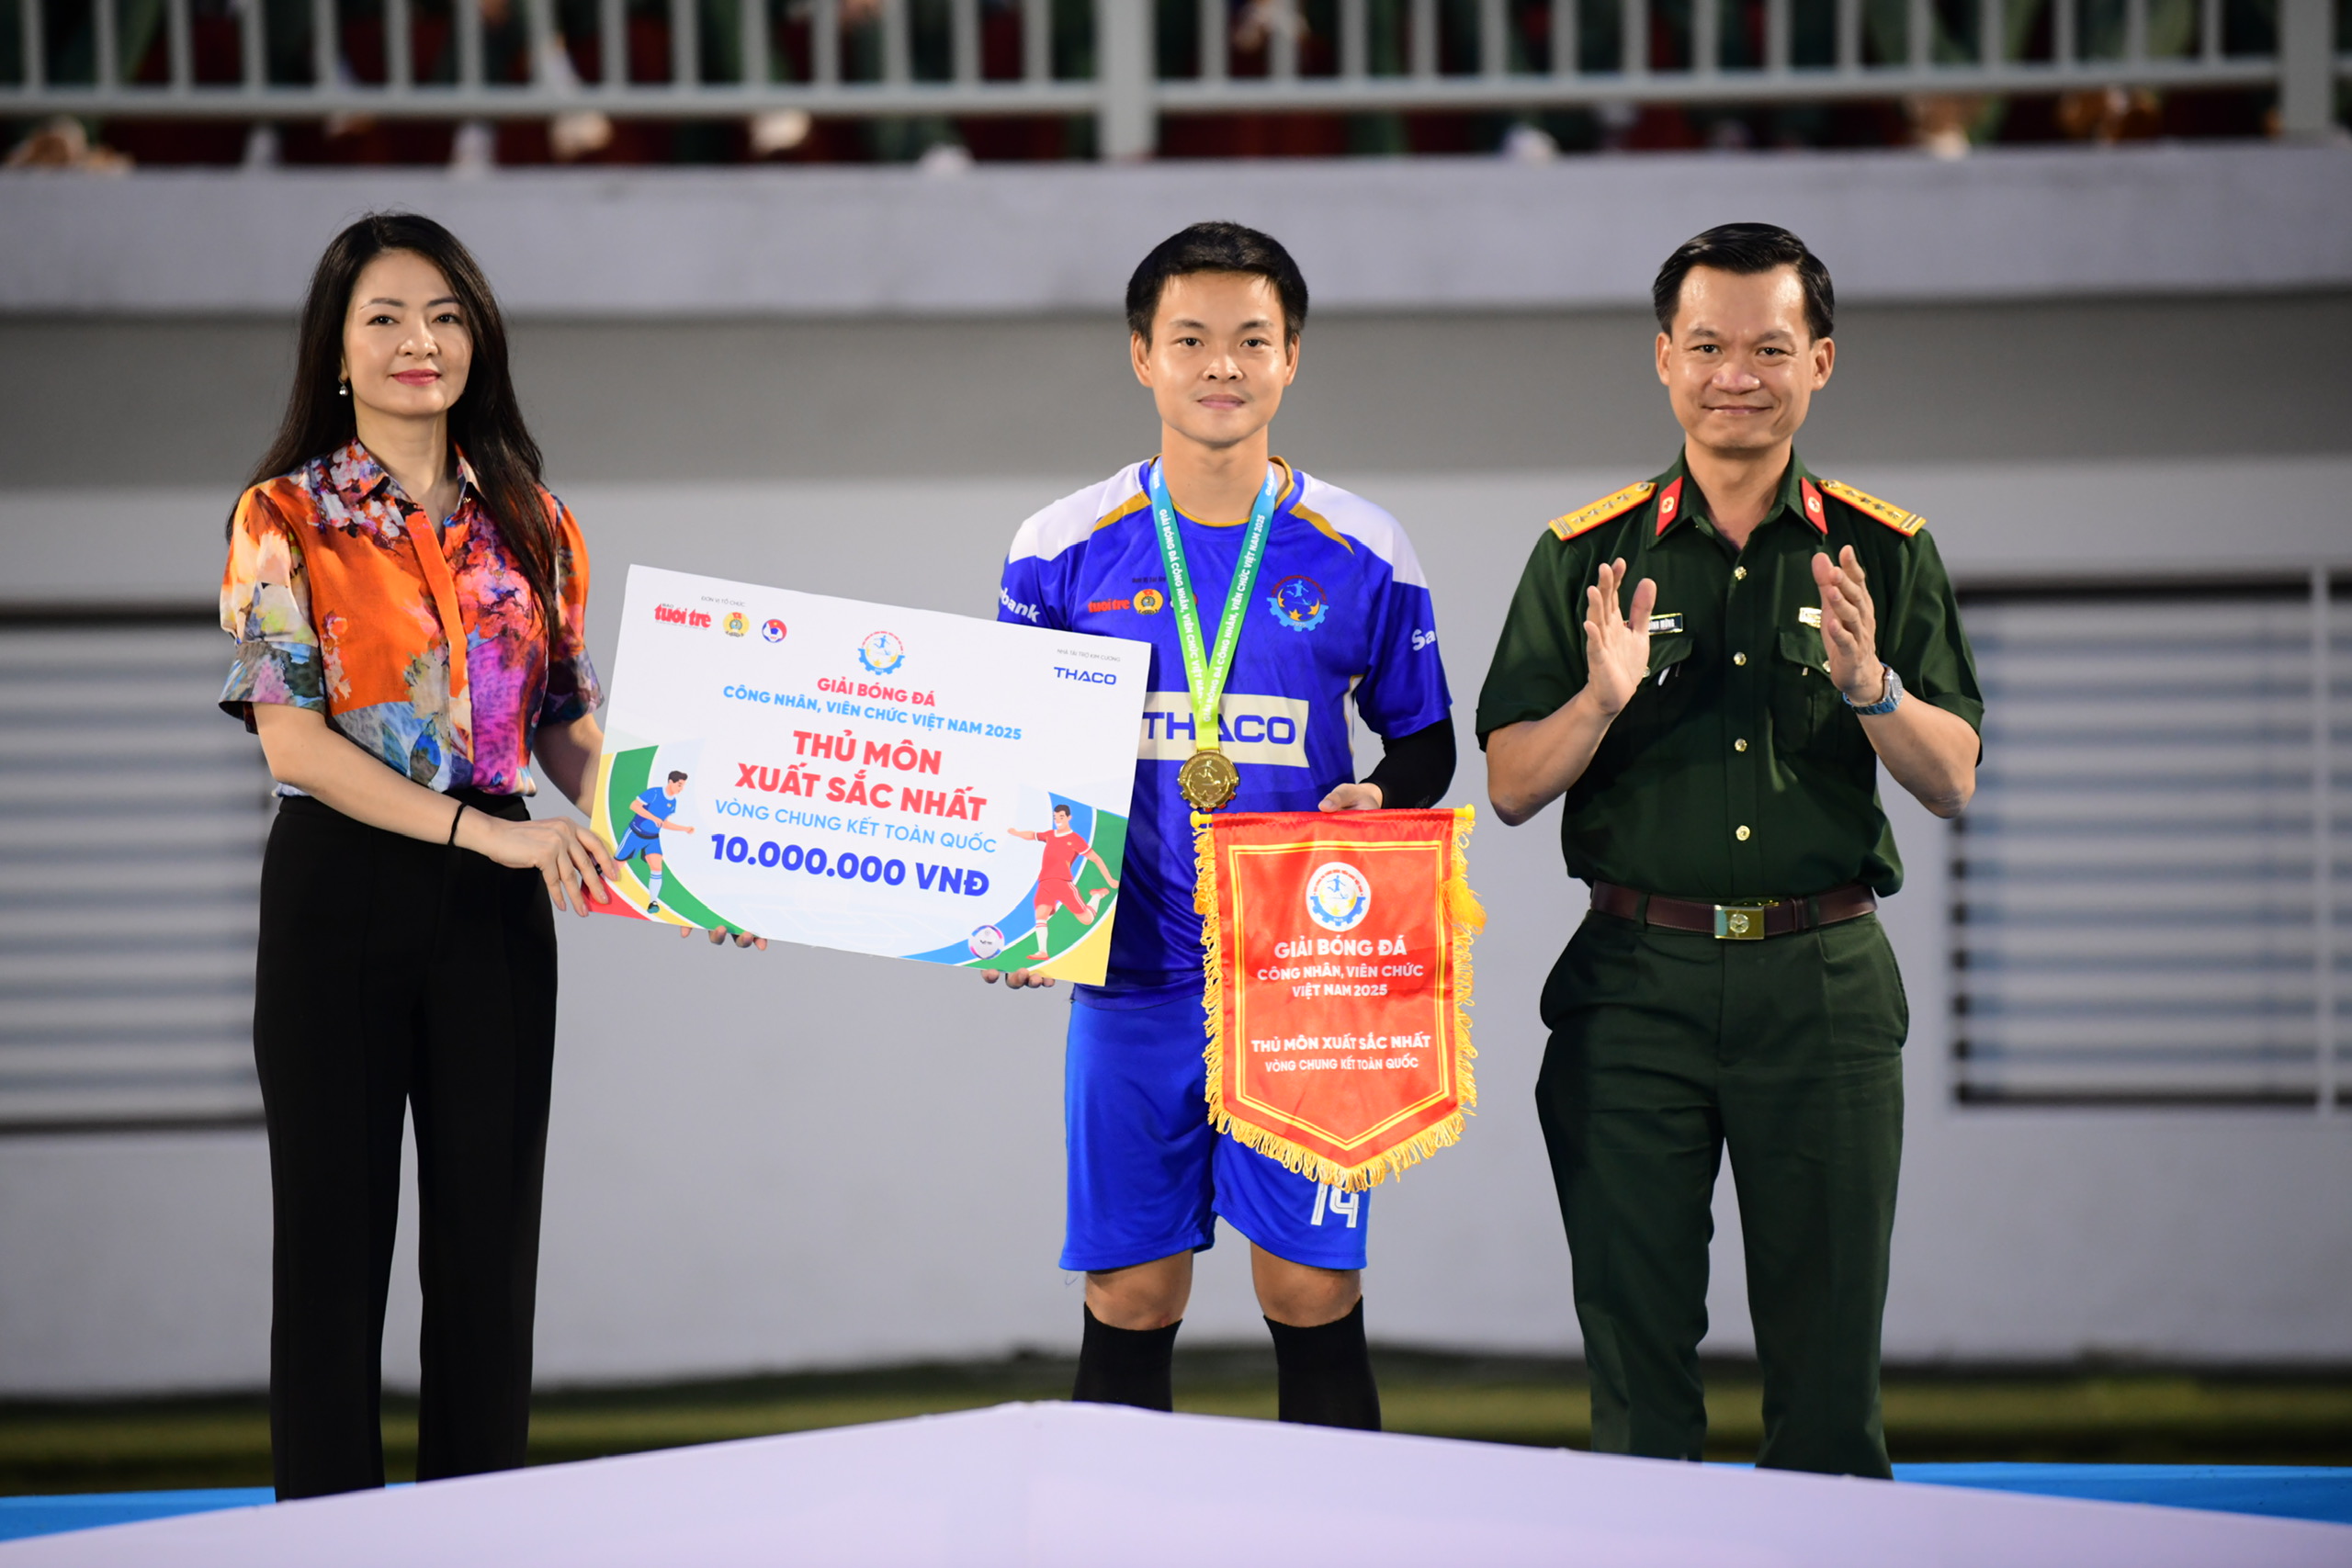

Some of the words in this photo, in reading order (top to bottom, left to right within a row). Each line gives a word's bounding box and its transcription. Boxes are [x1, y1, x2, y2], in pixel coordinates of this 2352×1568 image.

[1159, 509, 1171, 526] GIẢI
[1253, 513, 1266, 533] 2025
[1162, 525, 1175, 550] BÓNG
[1249, 531, 1261, 552] NAM
[1168, 550, 1180, 562] ĐÁ
[1243, 550, 1257, 569] VIỆT
[1170, 562, 1183, 588] CÔNG
[1237, 569, 1250, 592] CHỨC
[1001, 587, 1040, 623] bank
[1176, 587, 1190, 613] NHÂN,
[1231, 591, 1243, 612] VIÊN
[1182, 613, 1194, 634] VIÊN
[1225, 611, 1239, 638] NHÂN,
[1186, 634, 1200, 660] CHỨC
[1411, 628, 1436, 651] Sa
[1216, 638, 1230, 665] CÔNG
[1054, 666, 1116, 685] THACO
[1191, 660, 1204, 678] VIỆT
[1214, 666, 1224, 679] ĐÁ
[817, 677, 854, 696] GIẢI
[857, 682, 908, 703] BÓNG
[911, 690, 935, 706] ĐÁ
[723, 684, 771, 704] CÔNG
[774, 694, 821, 714] NHÂN,
[826, 700, 861, 717] VIÊN
[864, 706, 908, 724] CHỨC
[911, 713, 944, 731] VIỆT
[947, 718, 982, 735] NAM
[985, 724, 1022, 740] 2025
[793, 729, 857, 762] THỦ
[863, 739, 942, 775] MÔN
[735, 762, 821, 798] XUẤT
[825, 769, 894, 809] SẮC
[900, 785, 988, 821] NHẤT
[715, 797, 770, 820] VÒNG
[775, 808, 842, 830] CHUNG
[846, 817, 879, 837] KẾT
[884, 823, 935, 844] TOÀN
[940, 831, 997, 852] QUỐC
[711, 833, 906, 886] 10.000.000
[915, 862, 989, 897] VNĐ
[1274, 935, 1312, 959] GIẢI
[1317, 935, 1374, 956] BÓNG
[1377, 935, 1408, 956] ĐÁ
[1257, 966, 1300, 981] CÔNG
[1303, 963, 1344, 979] NHÂN,
[1346, 964, 1378, 978] VIÊN
[1382, 963, 1423, 977] CHỨC
[1293, 983, 1321, 999] VIỆT
[1324, 984, 1351, 997] NAM
[1353, 984, 1388, 997] 2025
[1251, 1036, 1281, 1053] THỦ
[1283, 1034, 1319, 1051] MÔN
[1322, 1032, 1356, 1050] XUẤT
[1359, 1032, 1387, 1050] SẮC
[1390, 1031, 1431, 1049] NHẤT
[1265, 1059, 1296, 1073] VÒNG
[1298, 1059, 1338, 1071] CHUNG
[1340, 1055, 1356, 1070] KẾT
[1357, 1057, 1383, 1070] TOÀN
[1385, 1053, 1419, 1070] QUỐC
[1310, 1182, 1360, 1228] 14
